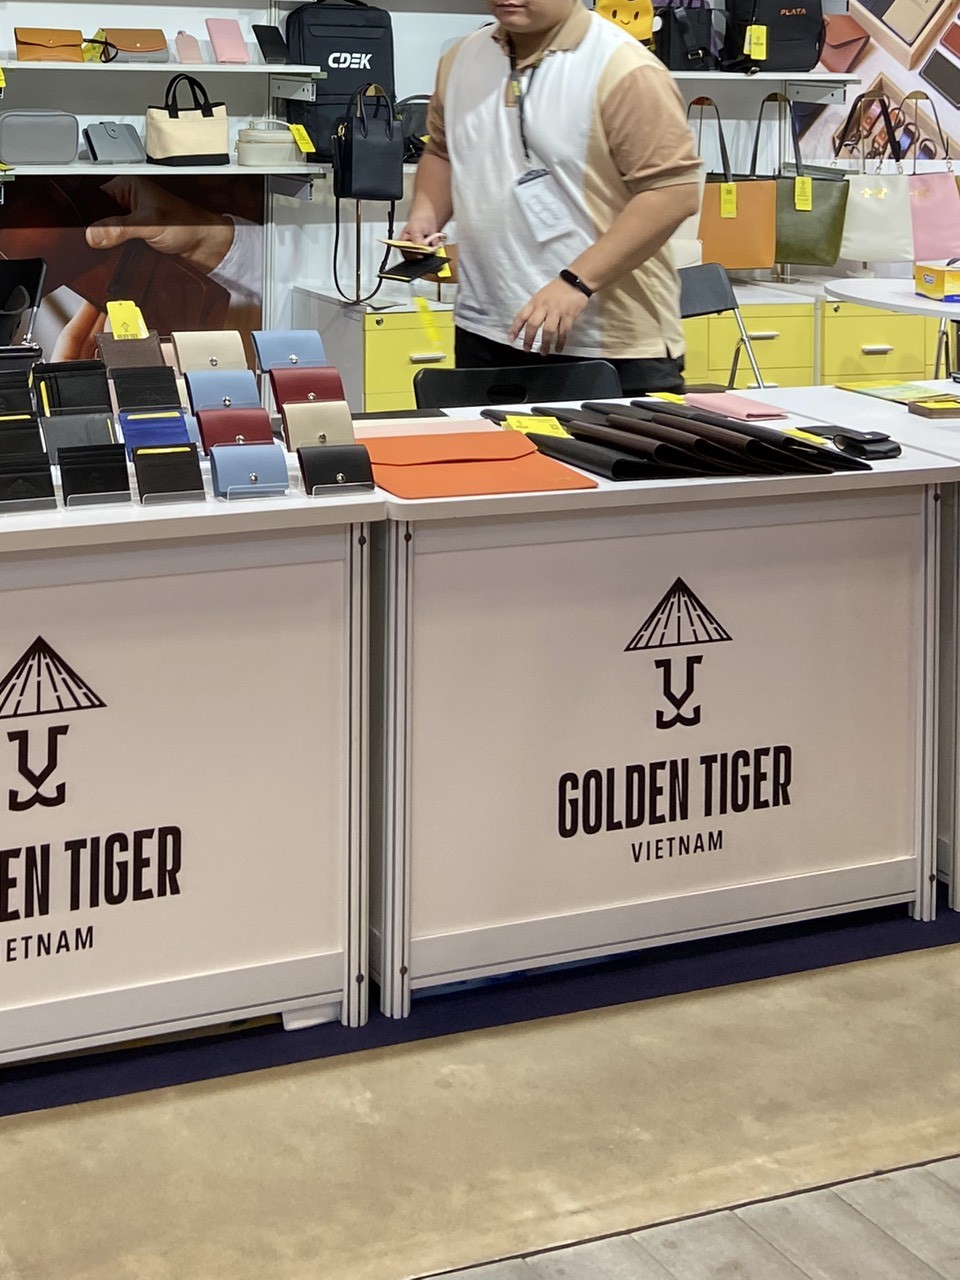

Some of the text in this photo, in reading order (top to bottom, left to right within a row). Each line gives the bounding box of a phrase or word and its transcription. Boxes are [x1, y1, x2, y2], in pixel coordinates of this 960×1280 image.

[328, 52, 372, 69] CDEK
[558, 745, 792, 839] GOLDEN TIGER
[64, 825, 182, 912] TIGER
[631, 830, 723, 863] VIETNAM
